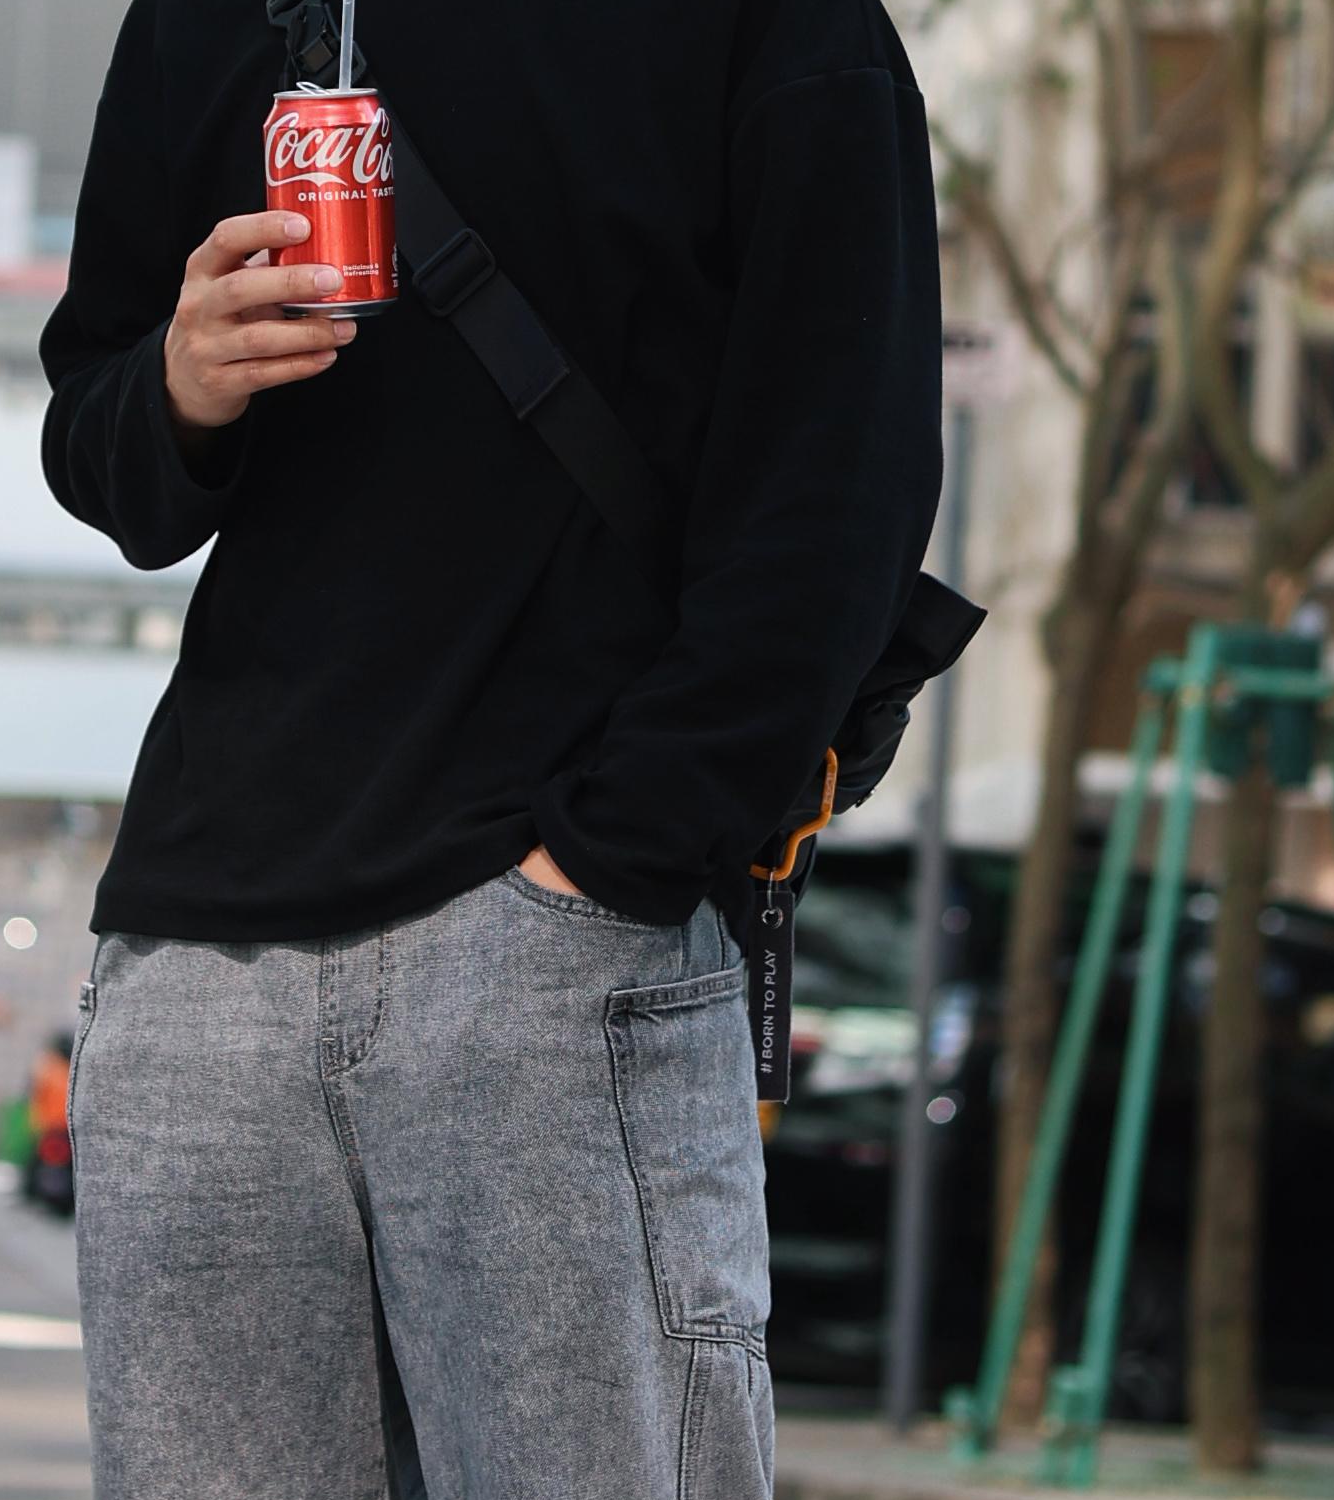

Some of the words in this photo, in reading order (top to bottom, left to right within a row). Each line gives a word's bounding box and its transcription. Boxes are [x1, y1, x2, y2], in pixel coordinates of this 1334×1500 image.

[265, 107, 395, 187] Coca-Co
[298, 189, 367, 201] ORIGINAL
[765, 949, 776, 985] PLAY
[764, 989, 776, 1011] TO
[762, 1015, 774, 1059] BORN
